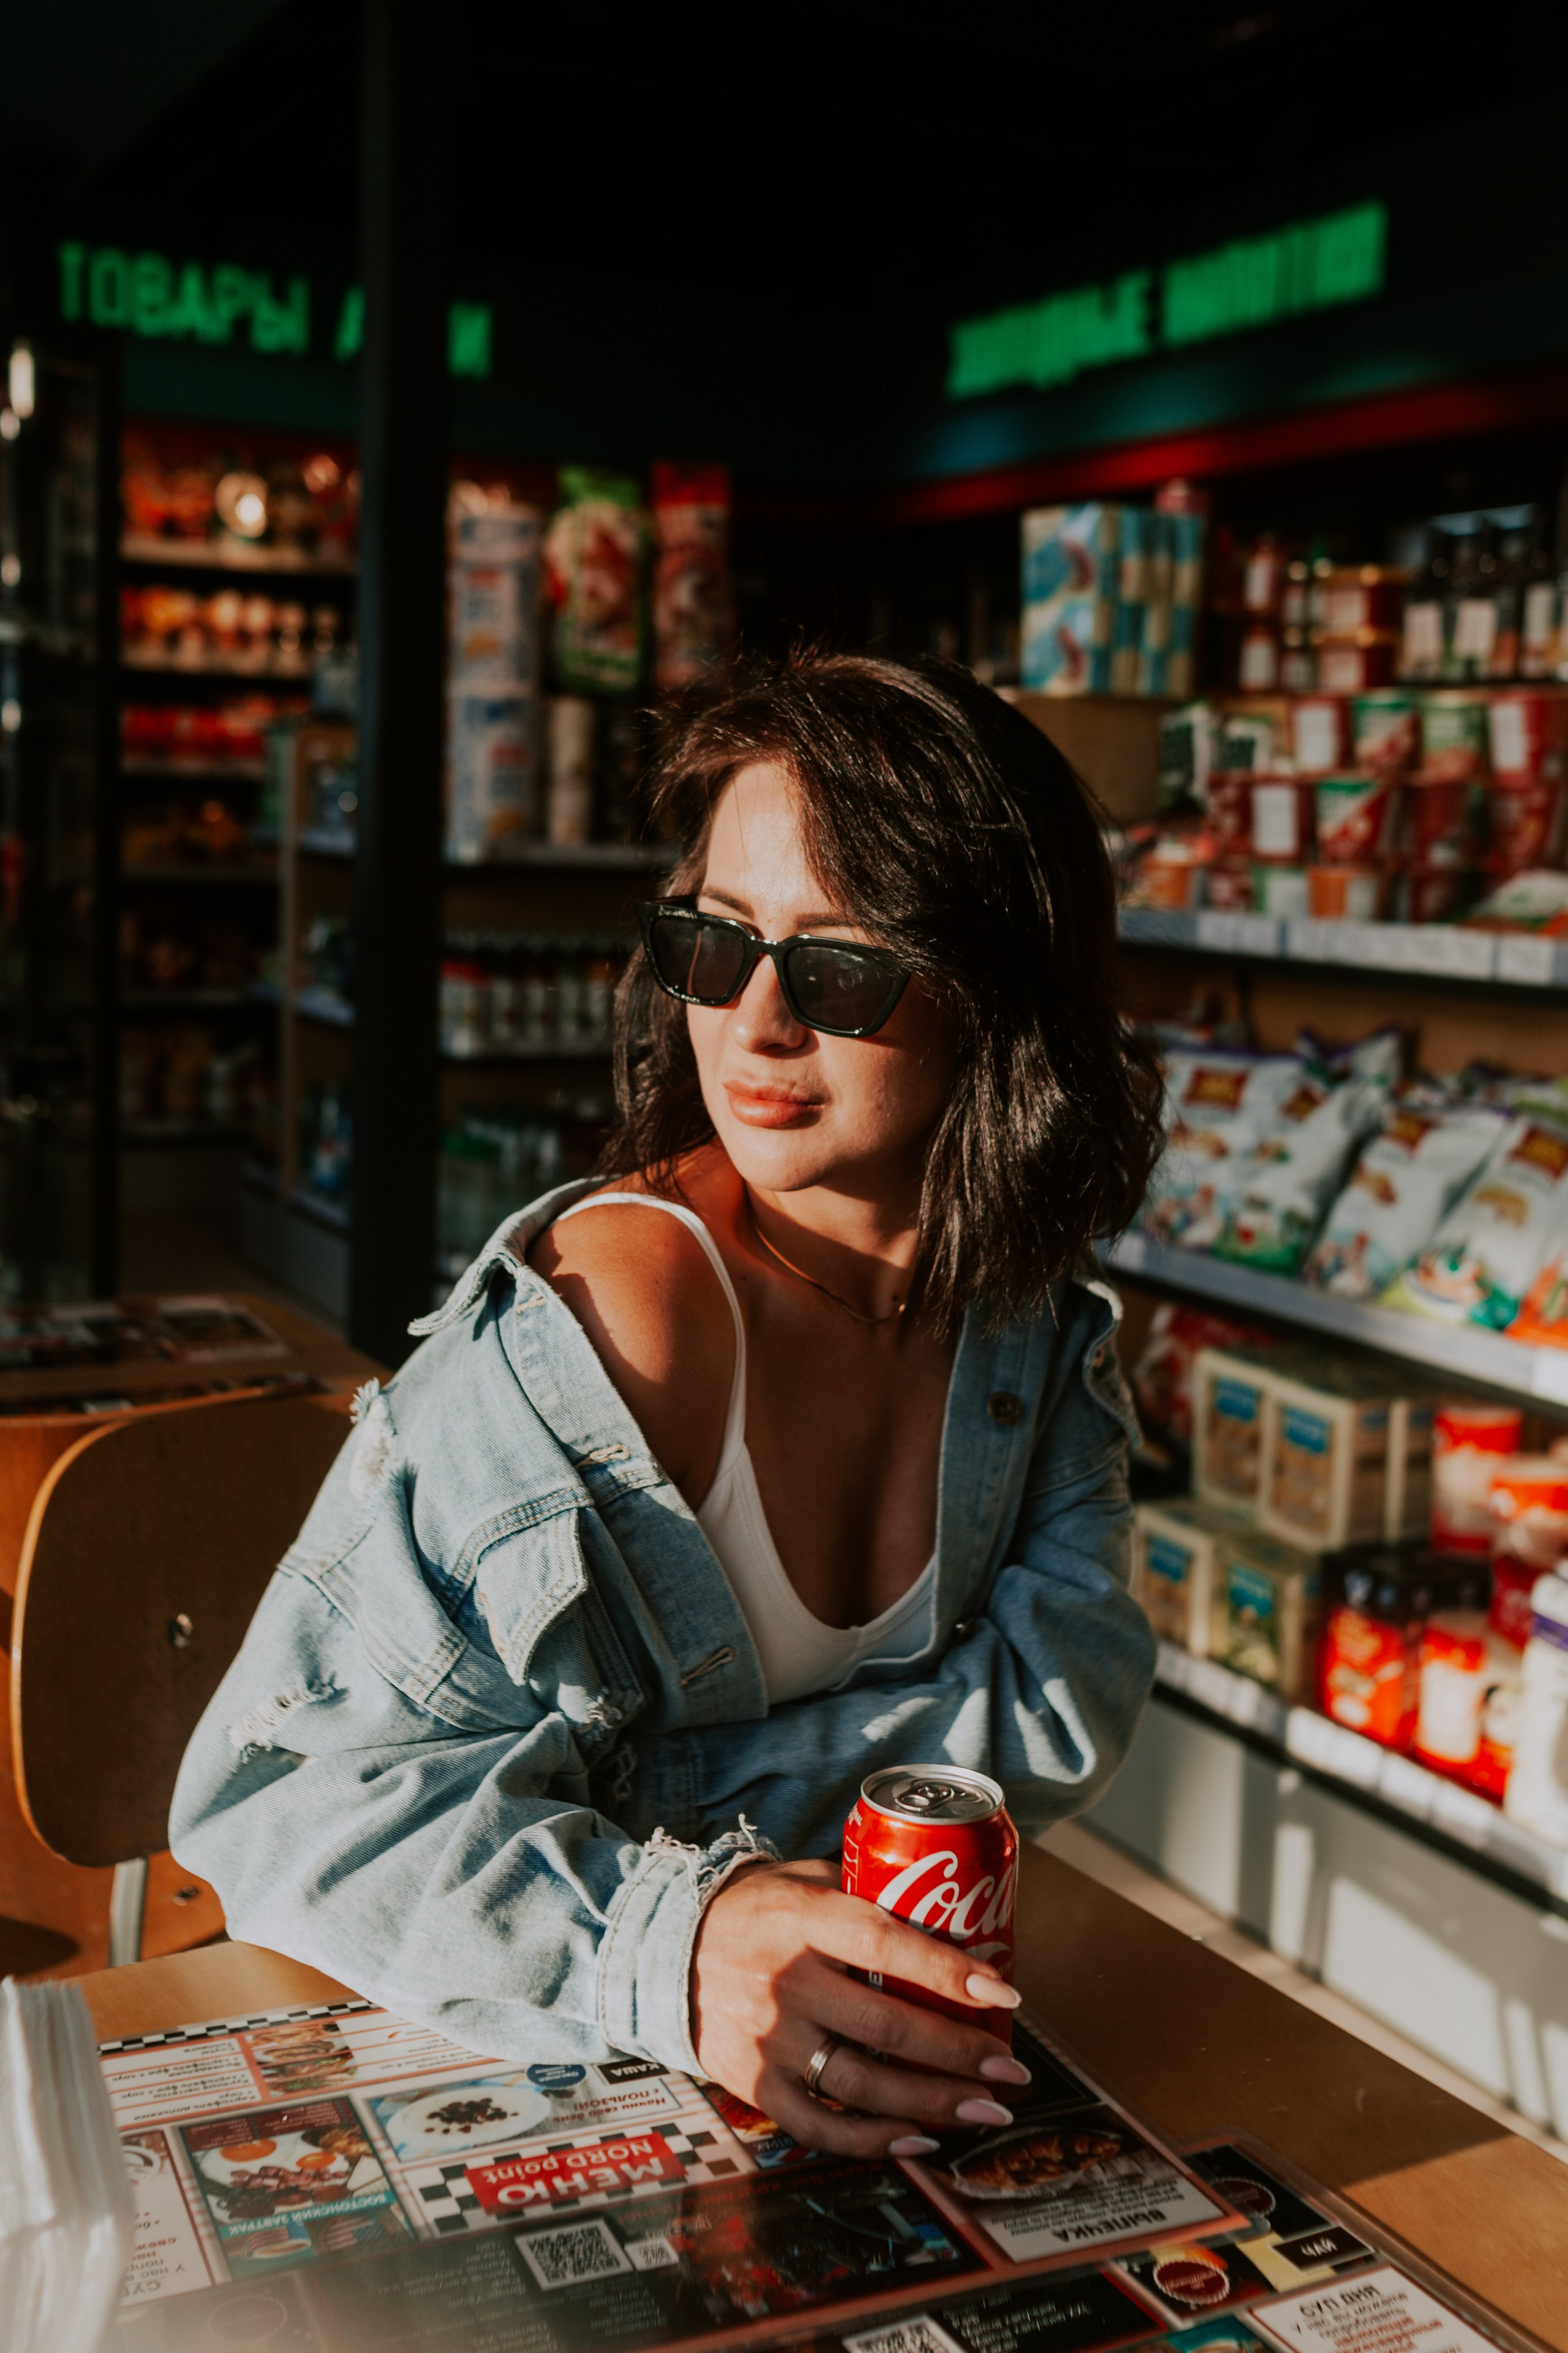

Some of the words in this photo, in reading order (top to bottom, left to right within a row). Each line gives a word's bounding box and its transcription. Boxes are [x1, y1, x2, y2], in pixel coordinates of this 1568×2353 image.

[57, 240, 311, 357] ТОВАРЫ
[876, 1850, 1017, 1941] Coca
[610, 2062, 660, 2076] КАША
[574, 2090, 649, 2112] ПОЛЬЗОЙ!
[589, 2107, 617, 2117] свой
[622, 2098, 665, 2110] Начни
[553, 2113, 584, 2123] день
[566, 2140, 652, 2167] NORD
[481, 2155, 559, 2184] point
[498, 2157, 664, 2205] МЕНЮ
[228, 2213, 288, 2235] ЗАВТРАК
[290, 2195, 387, 2226] БОСТОНСКИЙ
[1051, 2210, 1166, 2243] ВЫПЕЧКА
